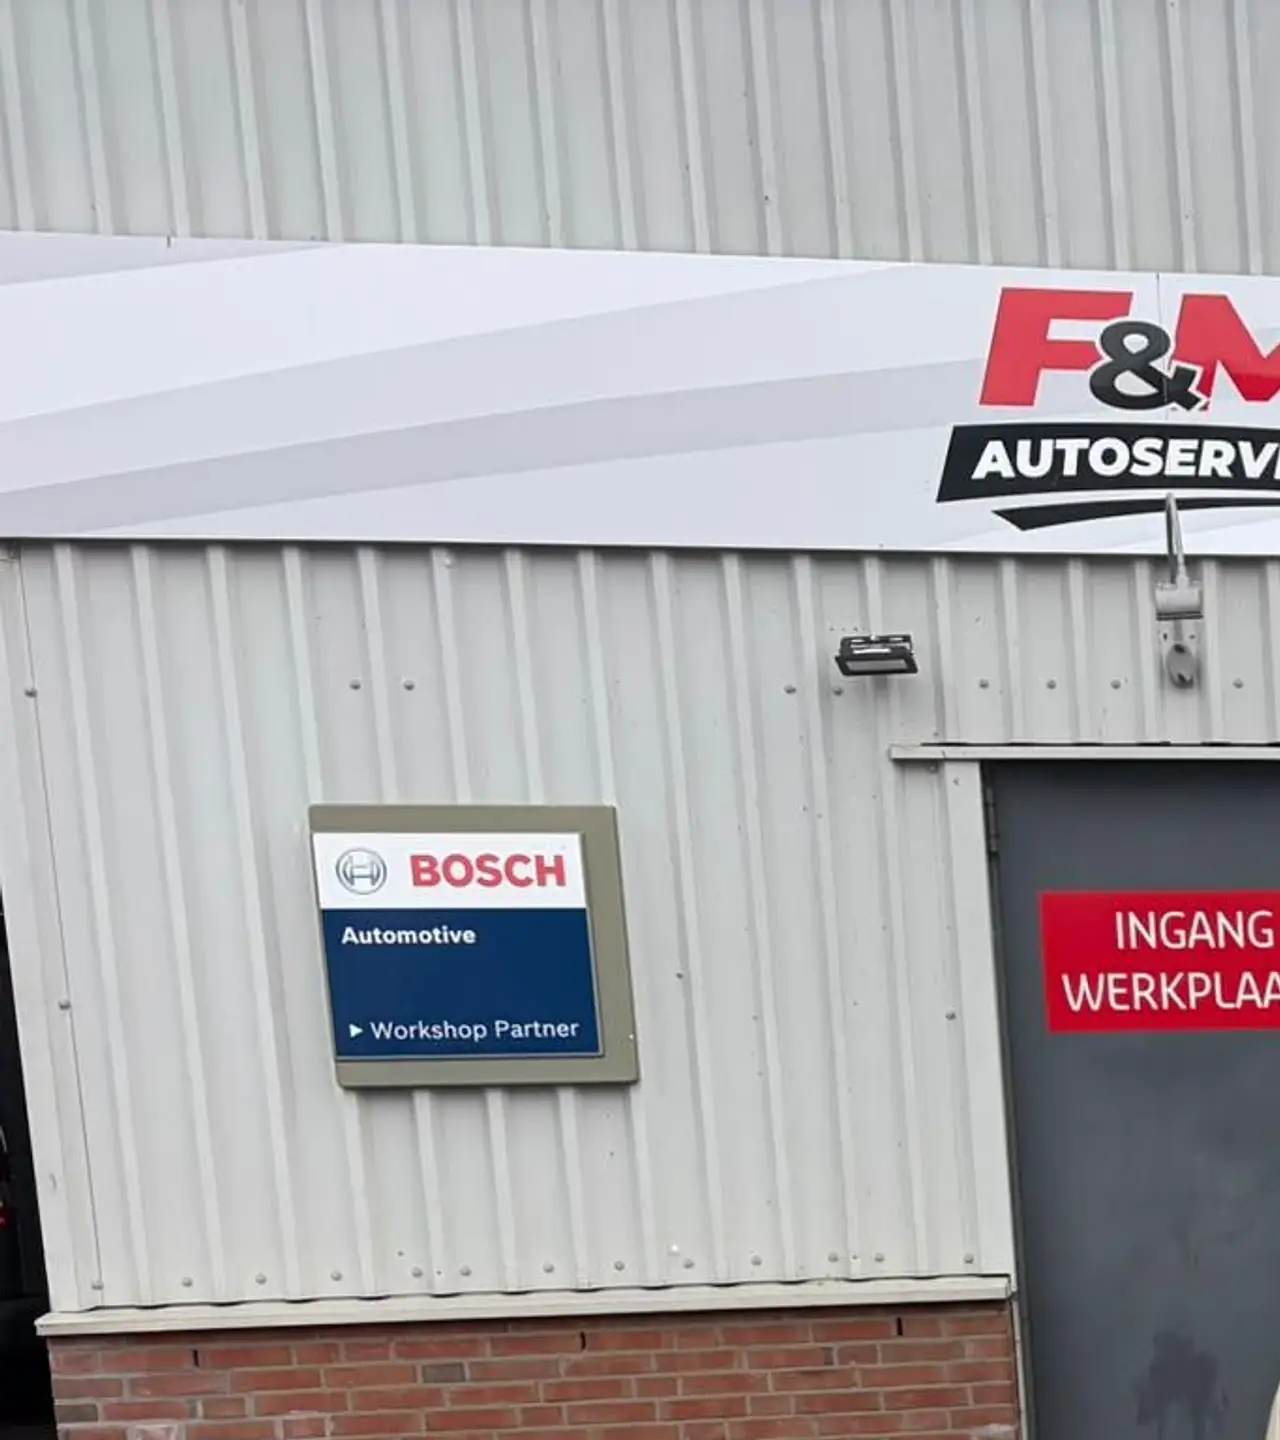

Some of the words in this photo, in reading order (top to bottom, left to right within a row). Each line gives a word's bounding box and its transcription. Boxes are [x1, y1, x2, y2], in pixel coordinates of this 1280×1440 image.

[410, 854, 566, 888] BOSCH
[341, 925, 477, 945] Automotive
[1115, 910, 1275, 949] INGANG
[370, 1021, 487, 1042] Workshop
[495, 1019, 580, 1038] Partner
